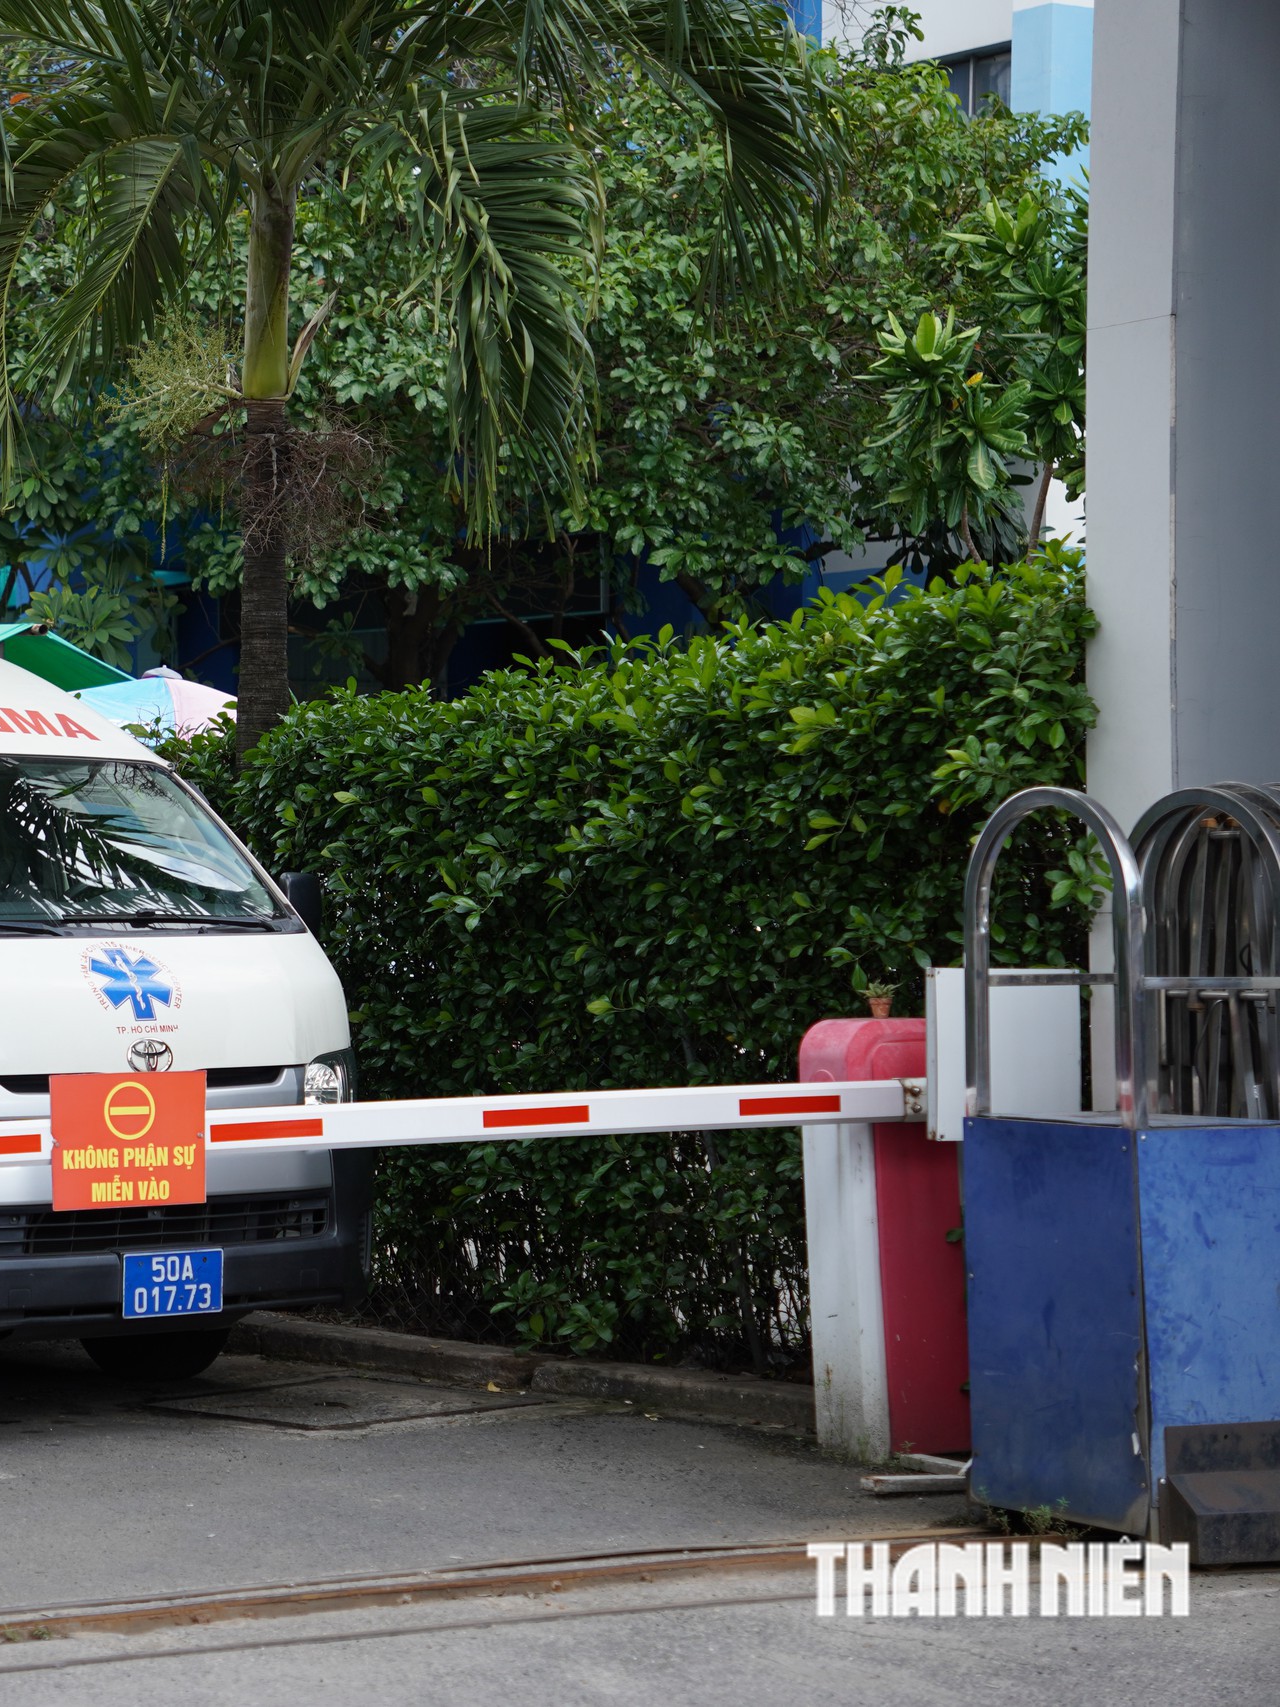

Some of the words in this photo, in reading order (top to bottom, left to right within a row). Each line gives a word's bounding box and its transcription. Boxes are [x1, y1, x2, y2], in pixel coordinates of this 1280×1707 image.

[63, 1145, 119, 1170] KHÔNG
[124, 1143, 168, 1171] PHẬN
[173, 1144, 196, 1170] SỰ
[91, 1175, 133, 1202] MIỄN
[138, 1177, 170, 1200] VÀO
[151, 1255, 194, 1283] 50A
[134, 1283, 212, 1314] 017.73
